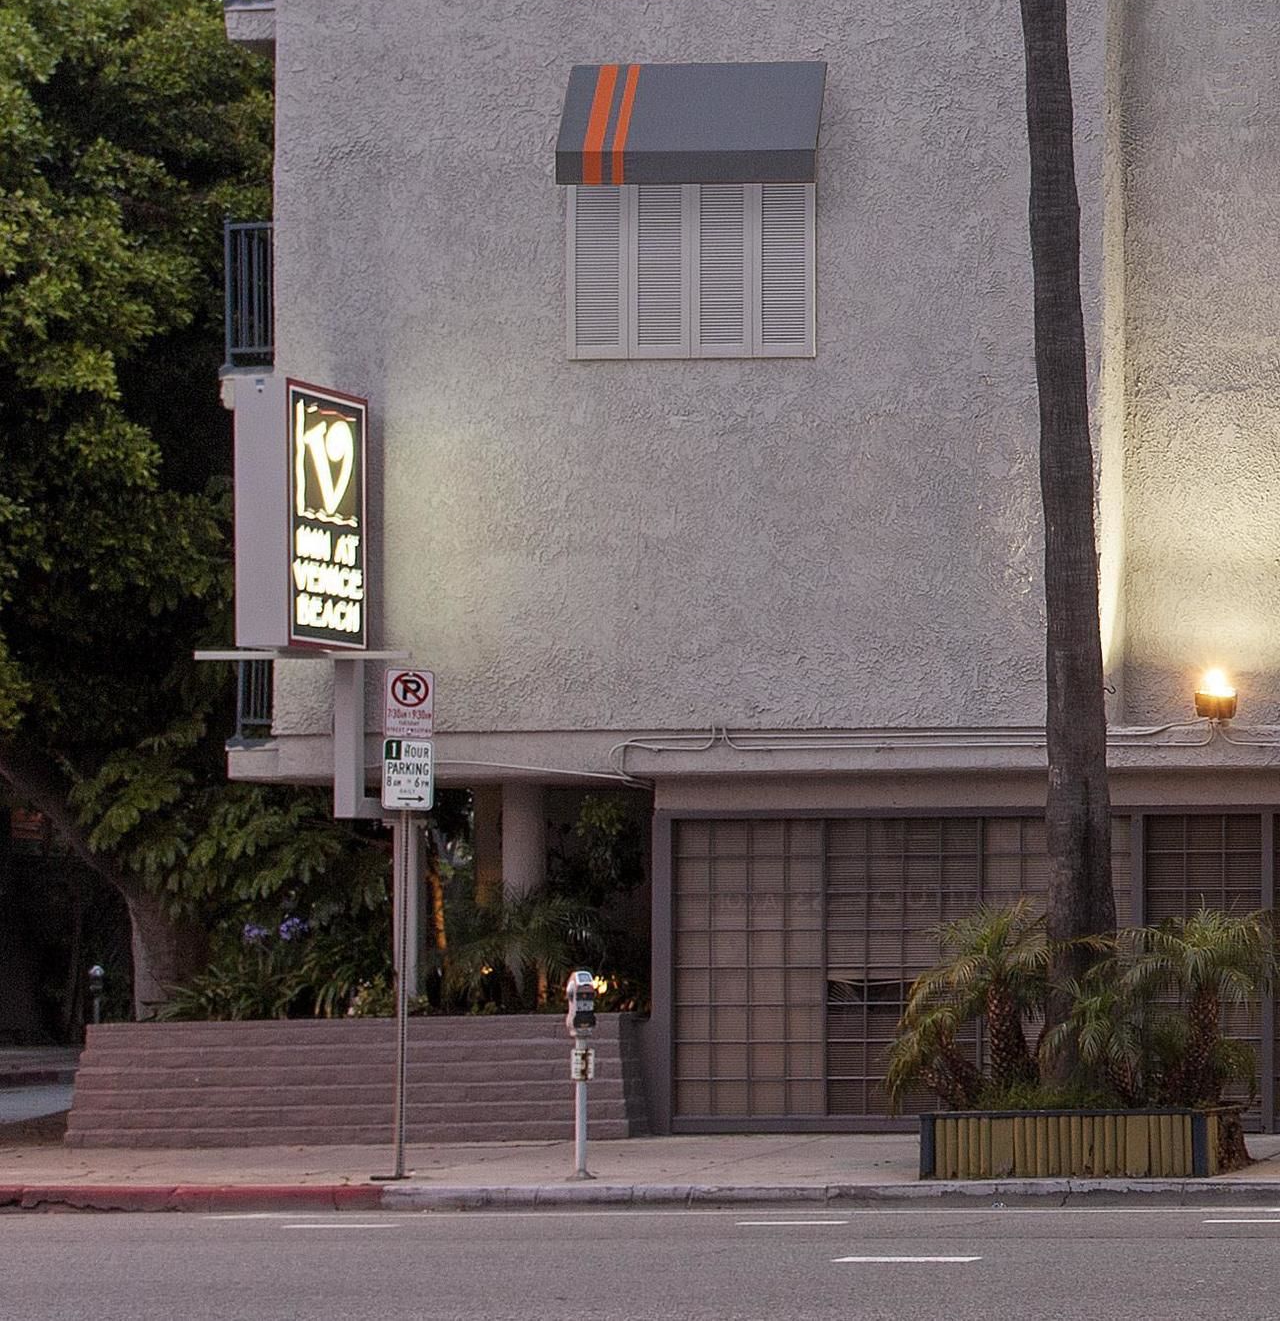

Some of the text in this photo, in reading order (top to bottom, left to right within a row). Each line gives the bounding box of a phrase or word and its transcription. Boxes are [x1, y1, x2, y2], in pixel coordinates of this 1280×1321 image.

[334, 534, 359, 566] AT
[293, 557, 363, 600] VENICE
[296, 592, 360, 633] BEACH
[391, 742, 429, 758] 1 HOUR
[387, 761, 429, 776] PARKING
